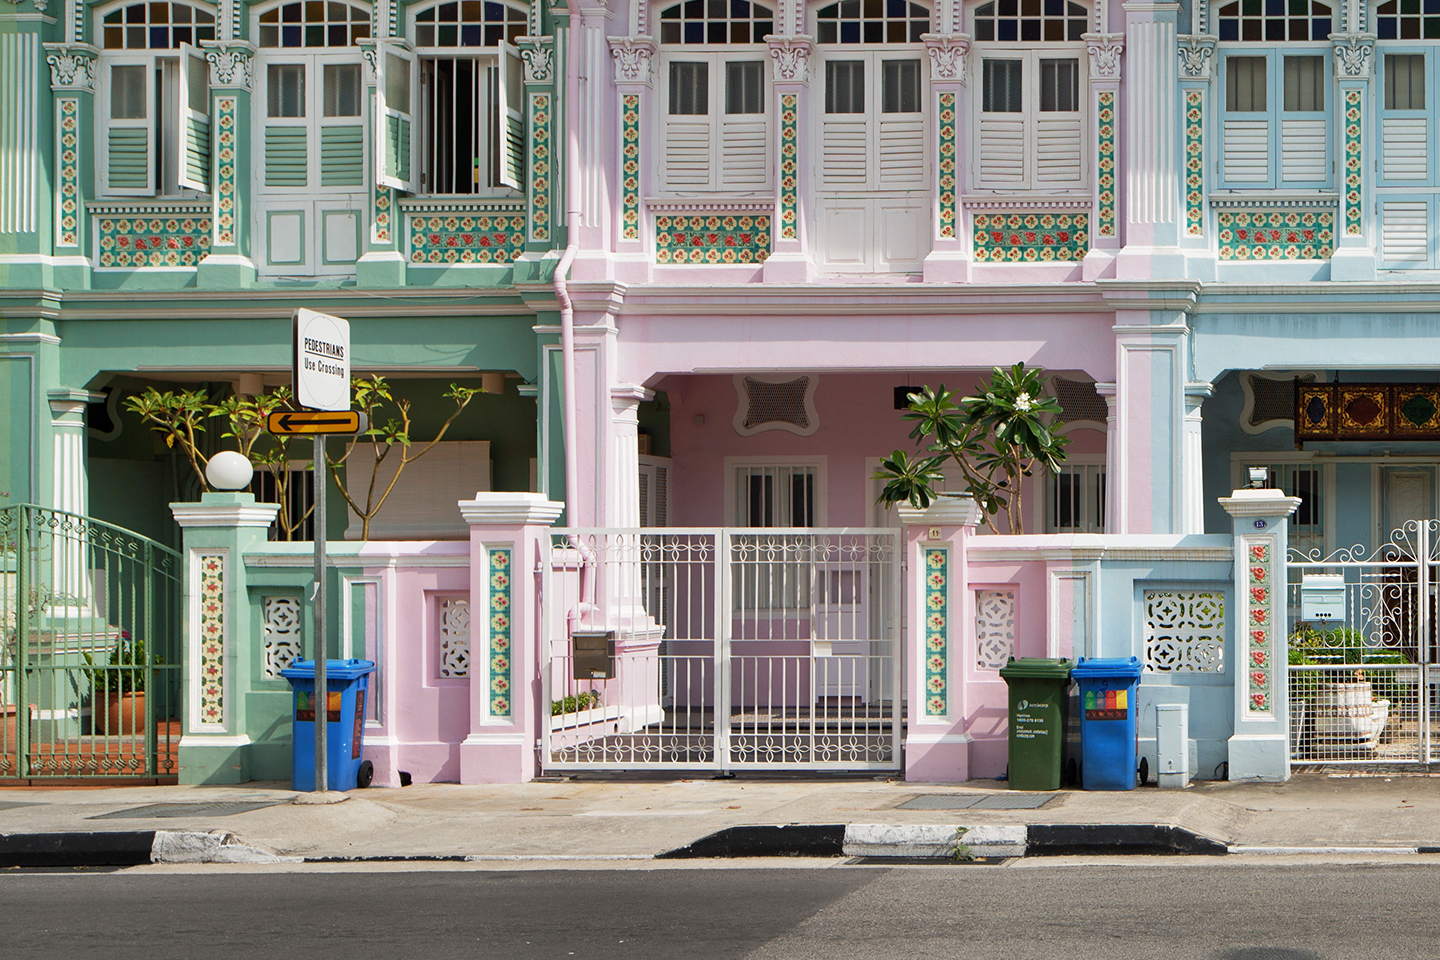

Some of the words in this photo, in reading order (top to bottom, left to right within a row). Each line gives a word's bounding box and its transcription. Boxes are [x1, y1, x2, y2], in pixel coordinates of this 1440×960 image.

[304, 337, 344, 358] PEDESTRIANS
[304, 357, 316, 371] Use
[318, 360, 344, 378] Crossing
